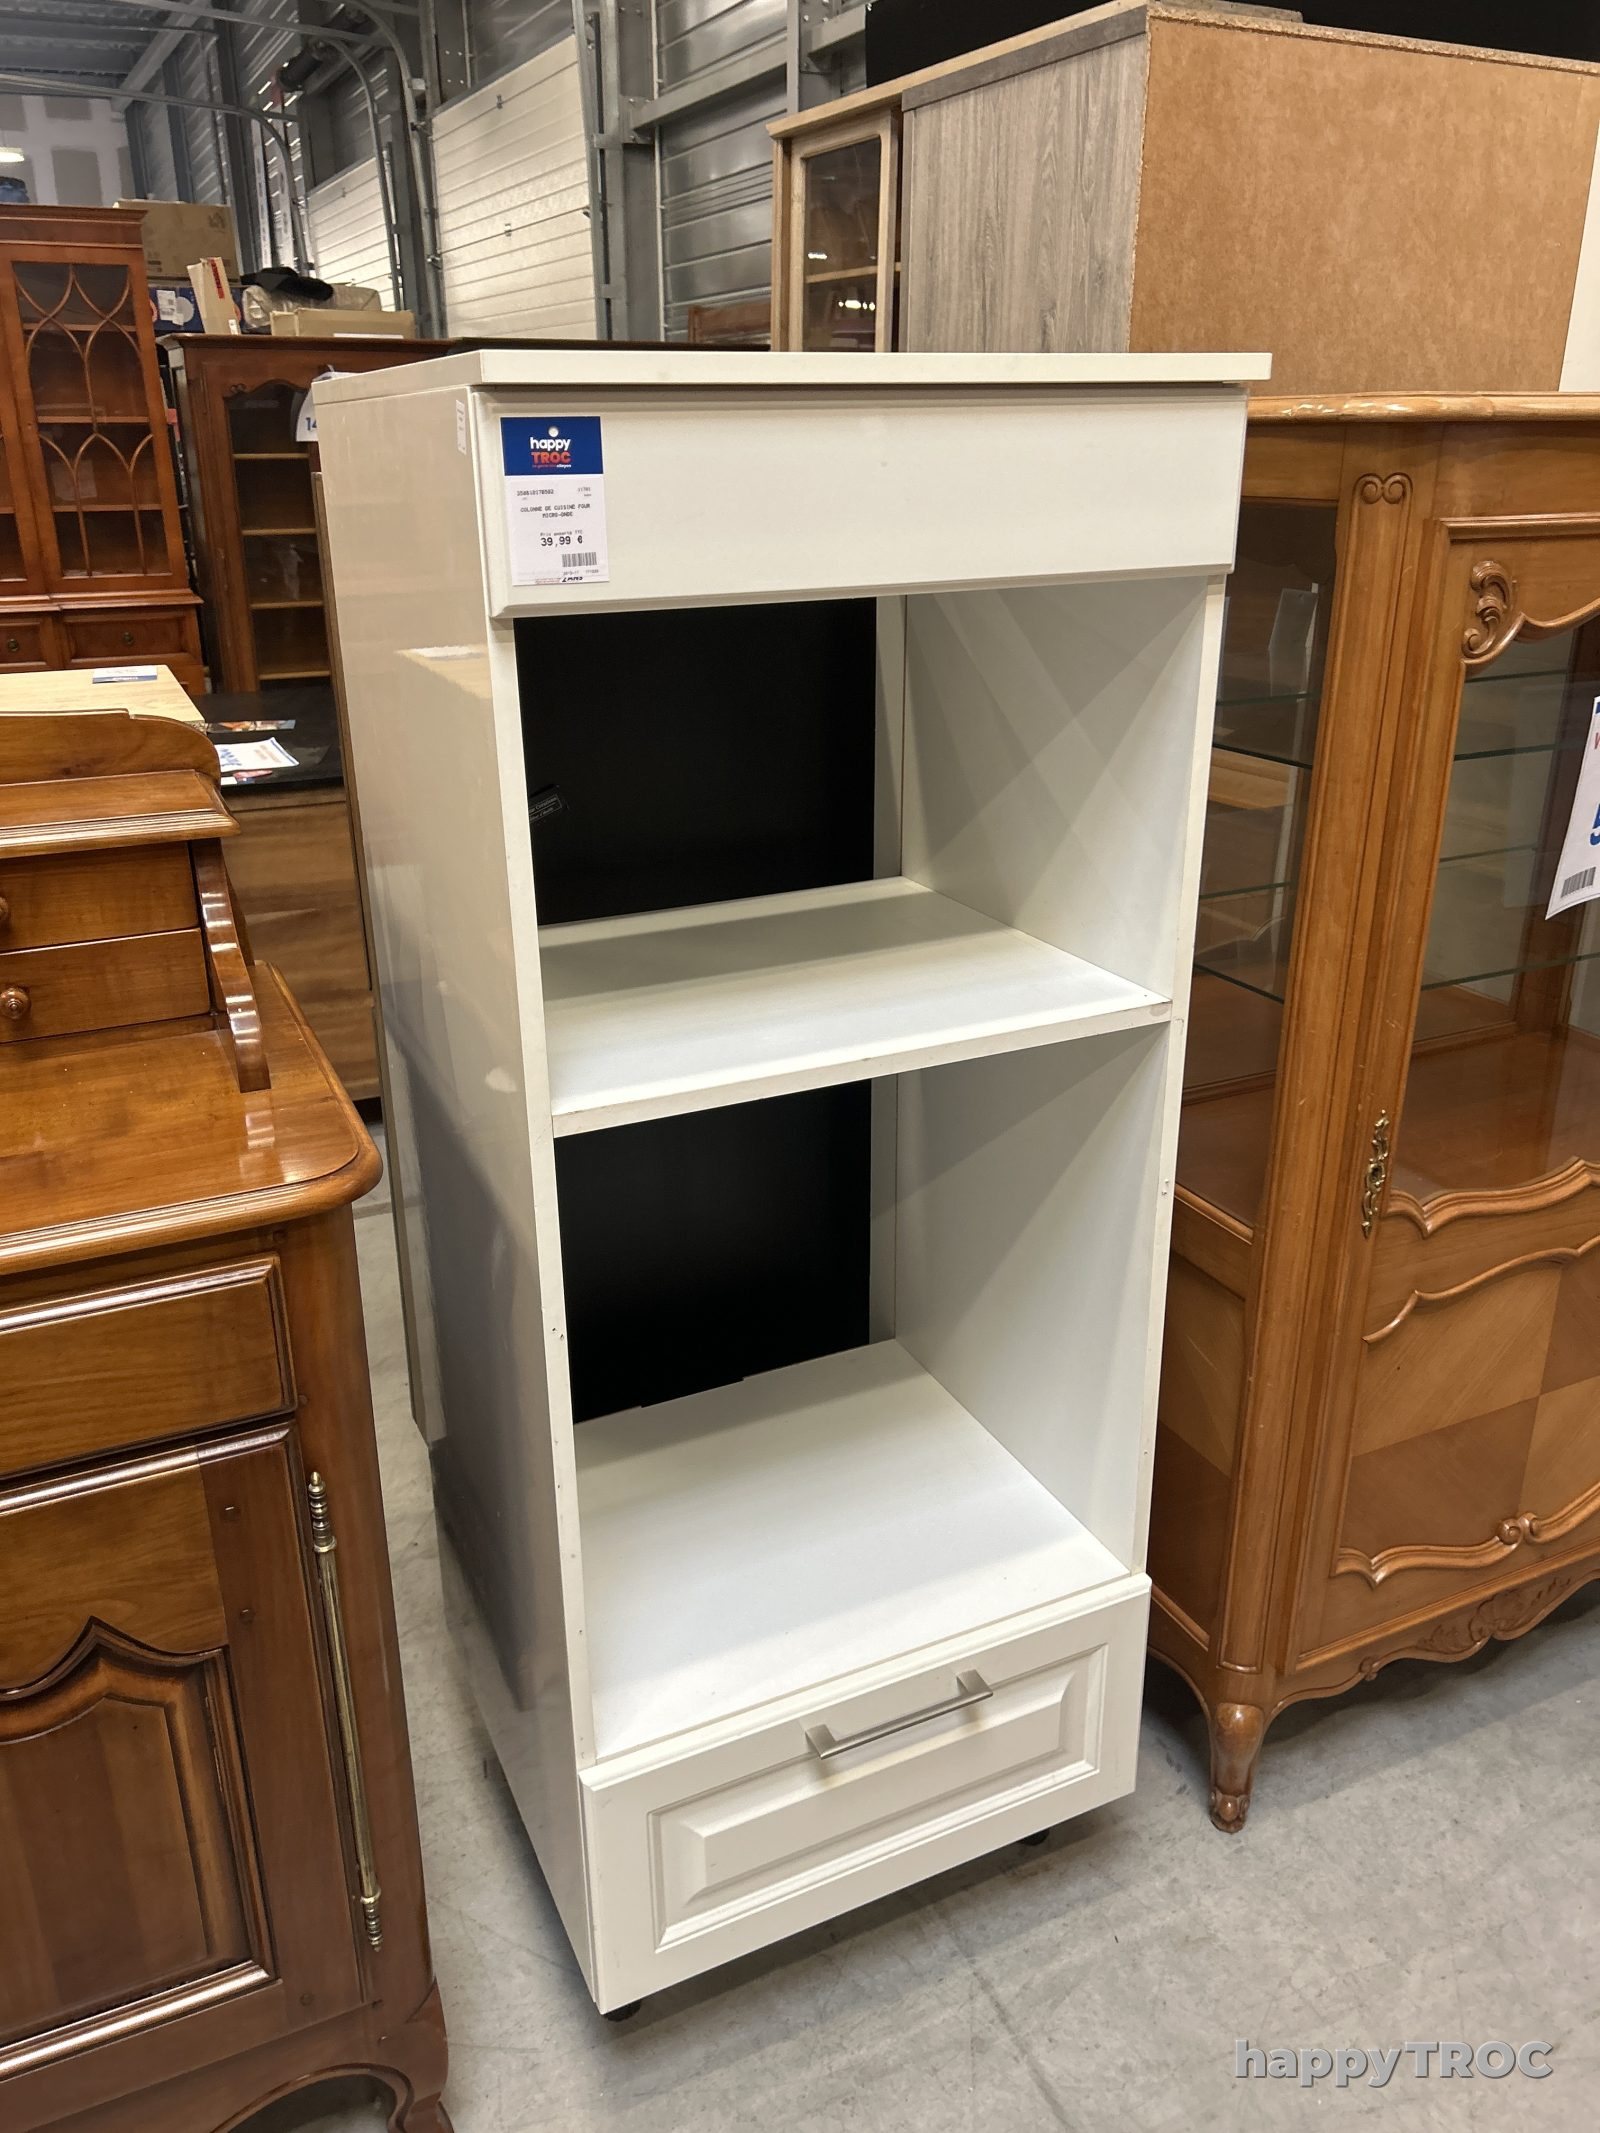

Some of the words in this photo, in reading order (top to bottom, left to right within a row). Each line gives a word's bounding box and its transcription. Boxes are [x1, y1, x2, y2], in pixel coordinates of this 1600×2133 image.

[530, 437, 571, 451] happy
[531, 452, 571, 464] TROC
[541, 536, 571, 547] 39,99
[577, 535, 583, 544] €
